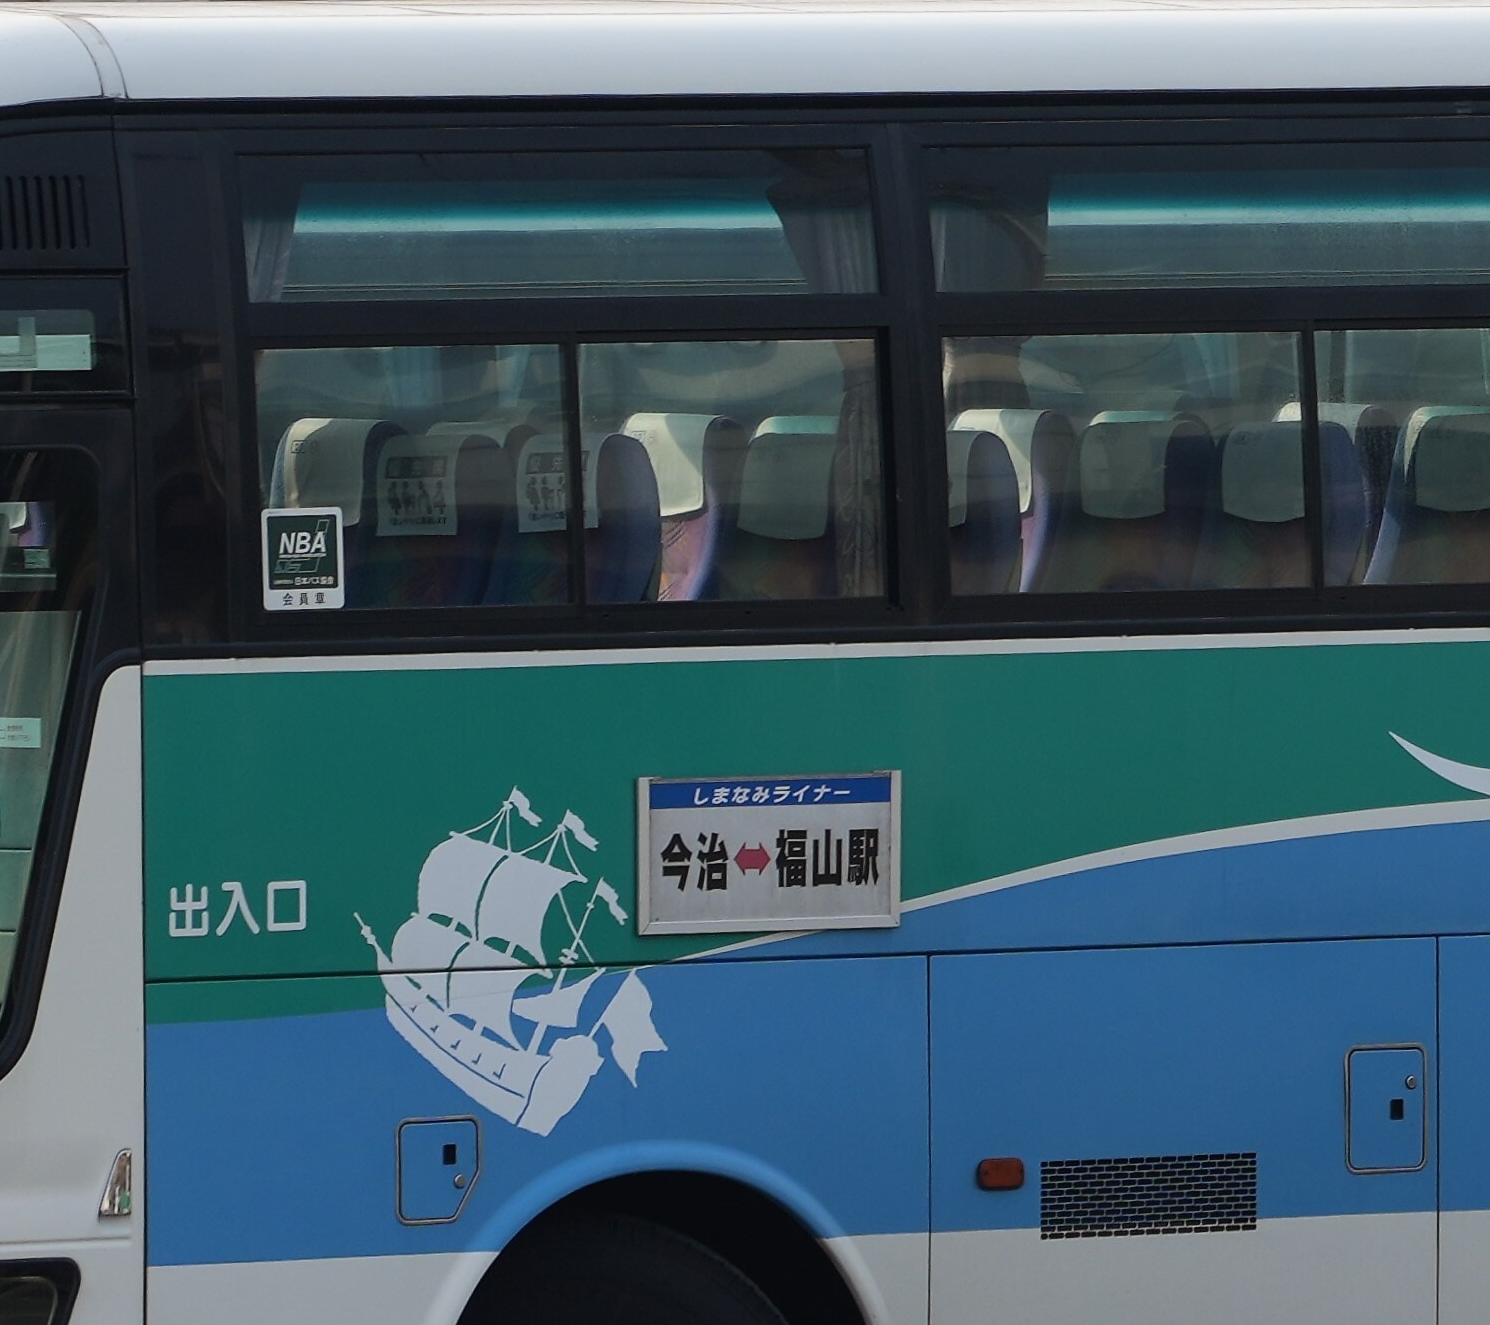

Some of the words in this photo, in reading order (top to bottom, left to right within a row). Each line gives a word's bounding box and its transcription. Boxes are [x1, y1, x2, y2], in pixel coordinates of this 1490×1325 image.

[279, 532, 326, 554] NBA
[692, 784, 851, 806] しまなみライナー
[660, 832, 729, 892] 今治
[775, 829, 880, 889] 福山駅
[168, 879, 307, 937] 出入口
